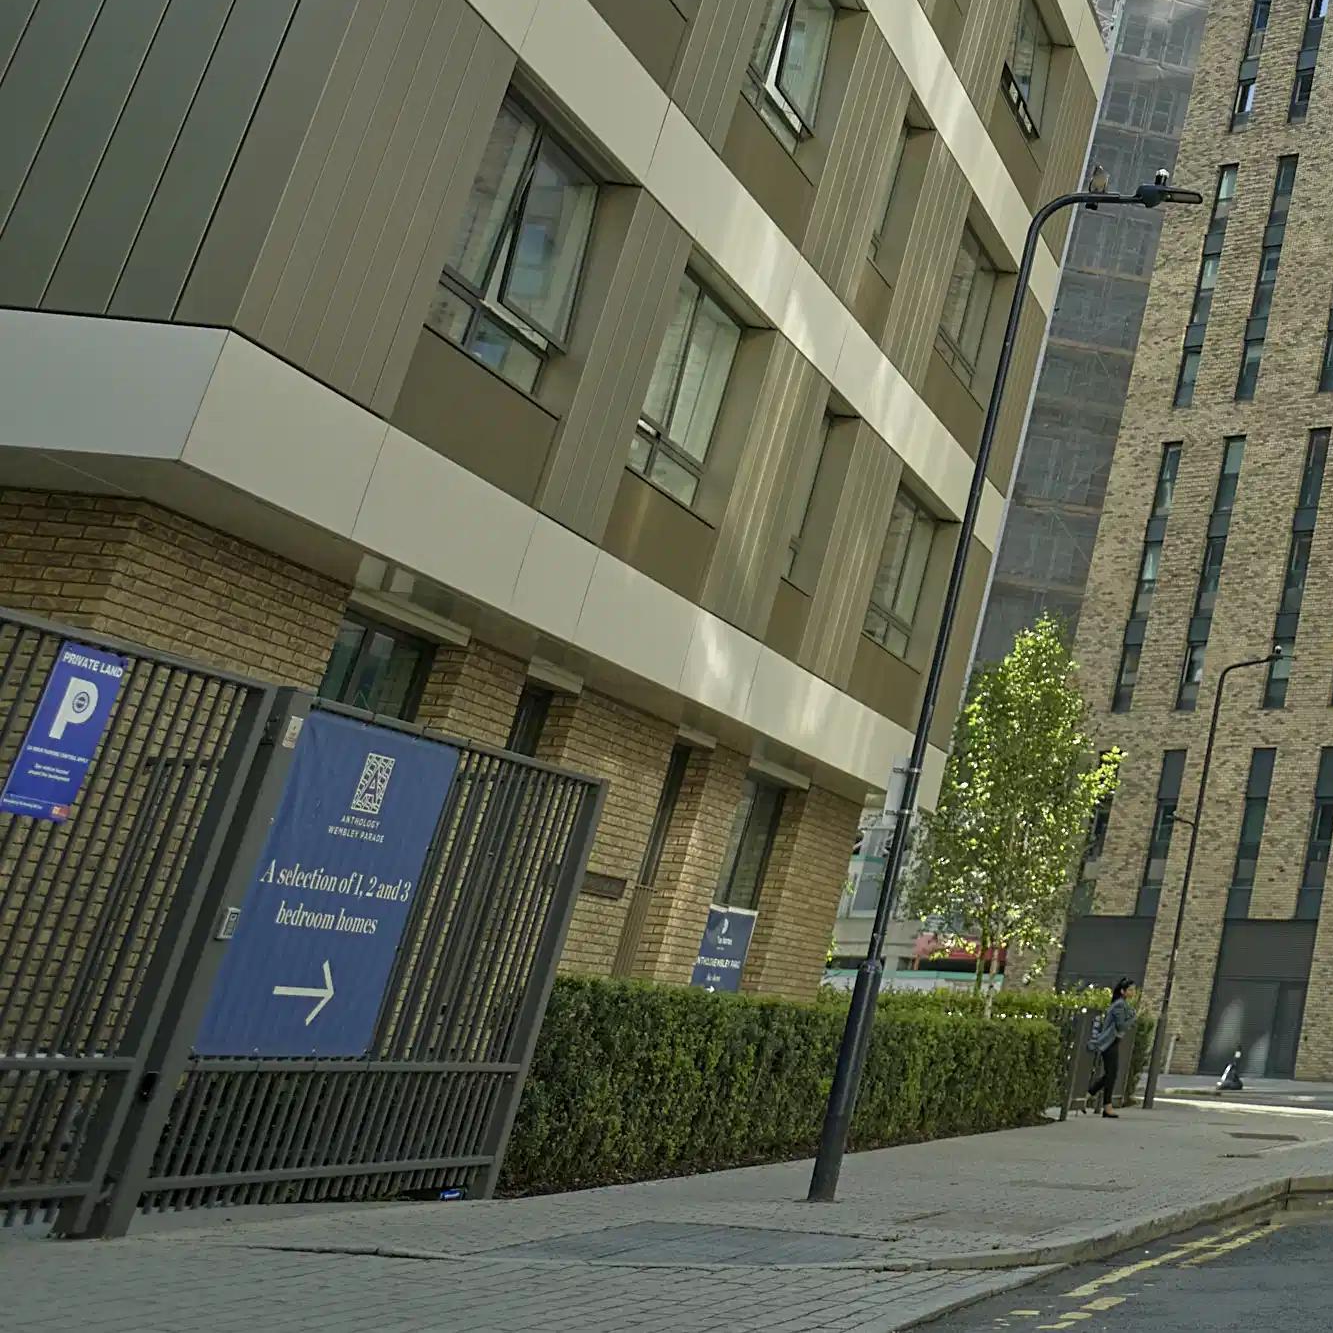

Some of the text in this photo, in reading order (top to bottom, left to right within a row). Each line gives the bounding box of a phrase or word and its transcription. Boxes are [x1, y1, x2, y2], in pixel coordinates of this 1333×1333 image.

[62, 651, 124, 678] PRIVATE LAND
[49, 676, 99, 740] P
[328, 826, 385, 844] WEMBLEY PARADE
[340, 815, 381, 830] ANTHOLOGY
[260, 859, 277, 884] A
[276, 863, 337, 894] selection
[338, 872, 358, 896] of
[365, 876, 378, 898] 2
[377, 879, 402, 901] and
[400, 881, 413, 902] 3
[275, 900, 379, 935] bedroom homes
